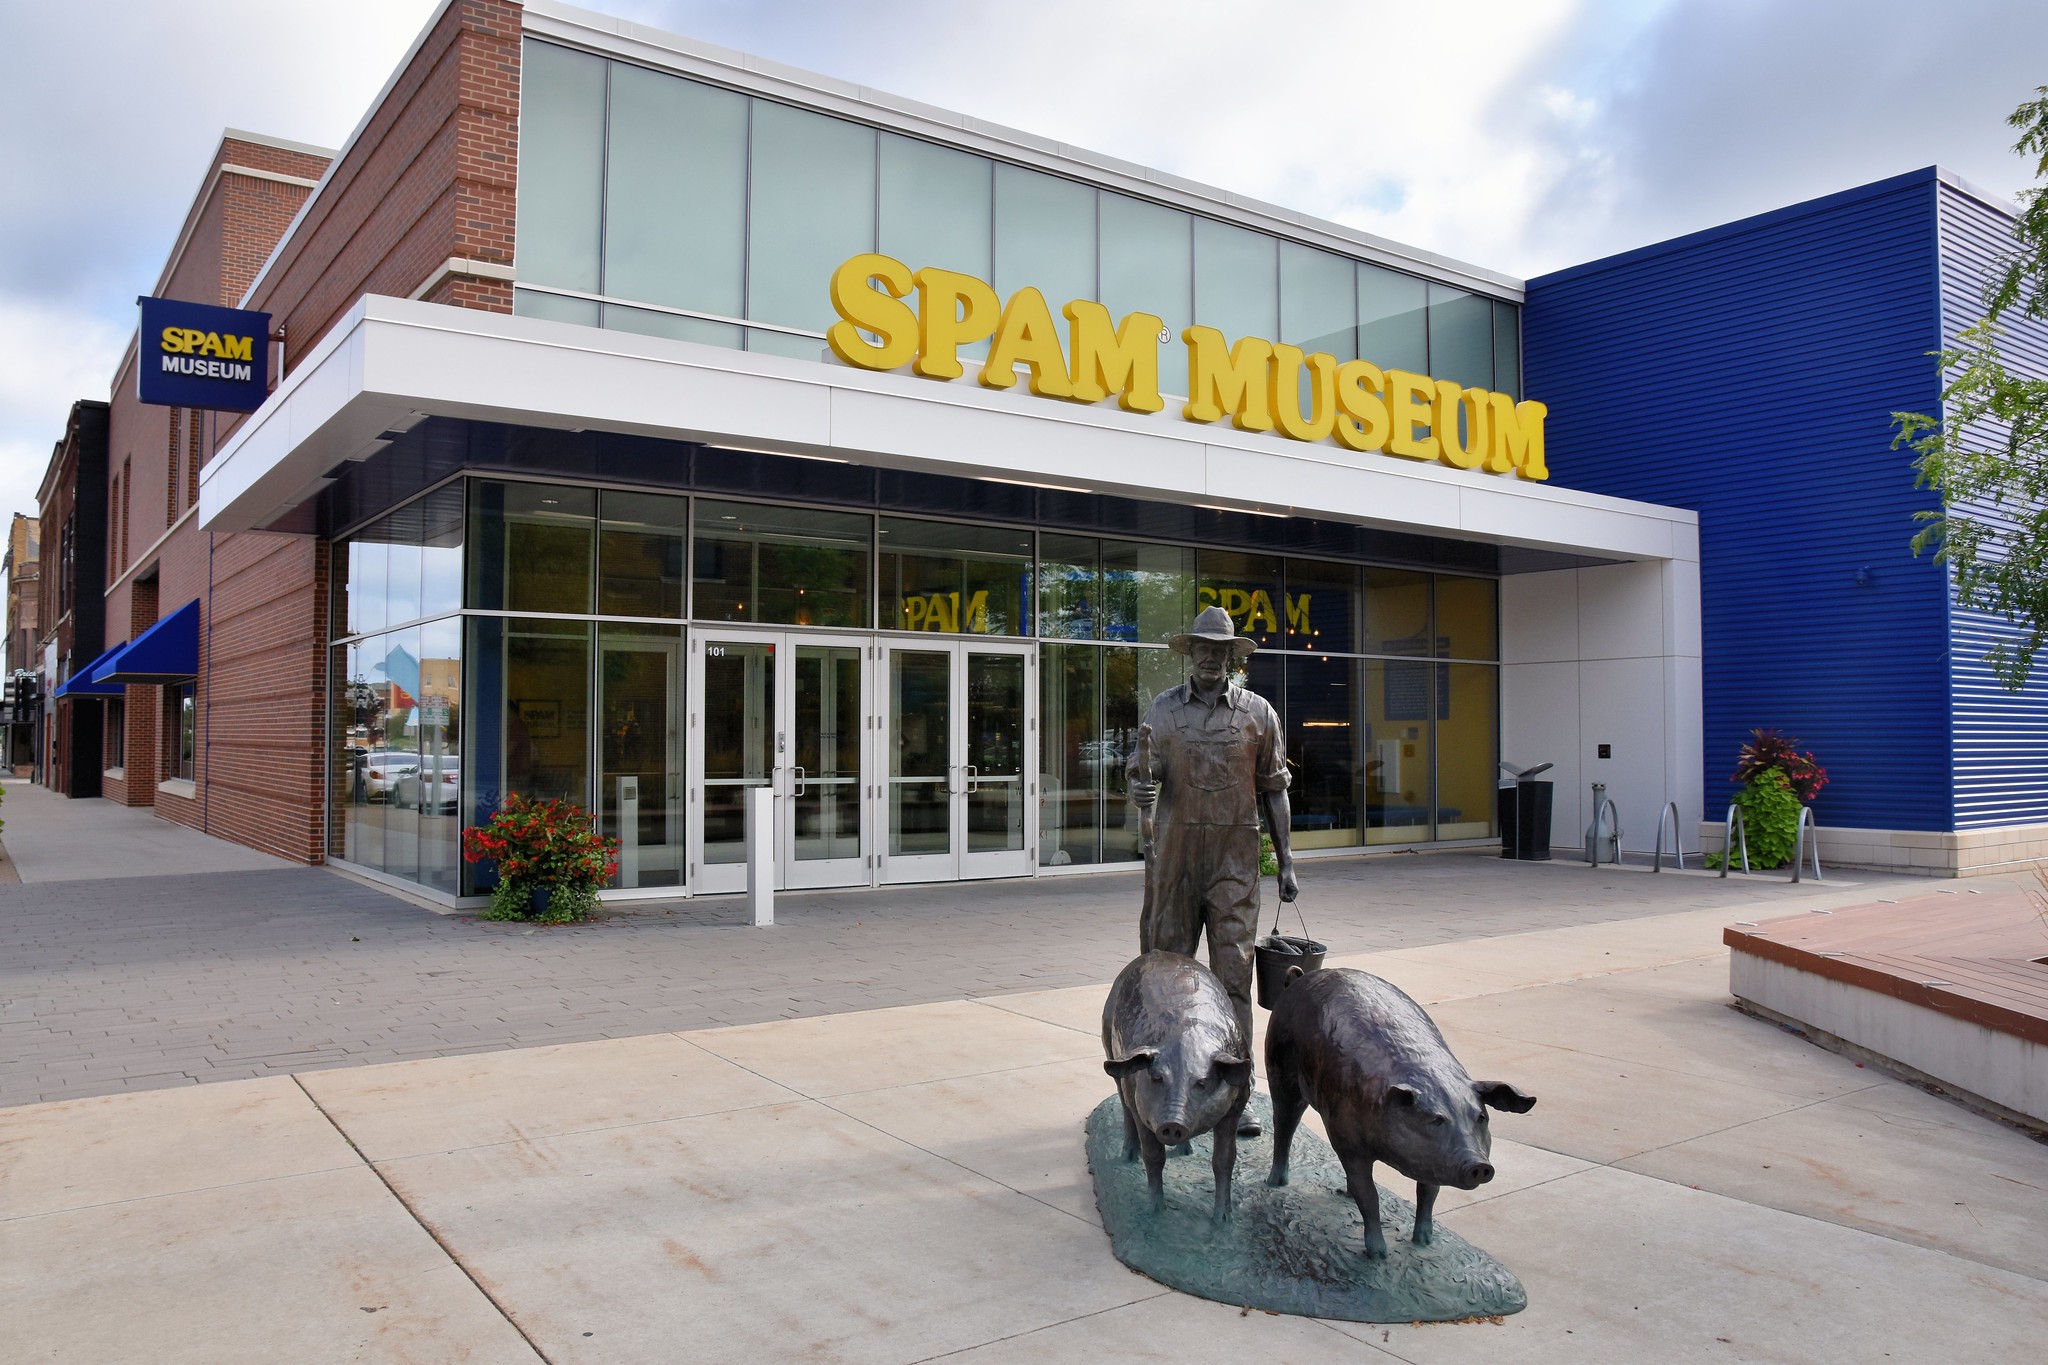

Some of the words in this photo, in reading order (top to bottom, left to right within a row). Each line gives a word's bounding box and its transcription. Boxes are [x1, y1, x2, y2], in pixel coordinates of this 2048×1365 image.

[161, 327, 254, 361] SPAM
[162, 355, 251, 381] MUSEUM
[1181, 324, 1549, 483] MUSEUM
[901, 590, 989, 633] PAM
[707, 647, 725, 657] 101
